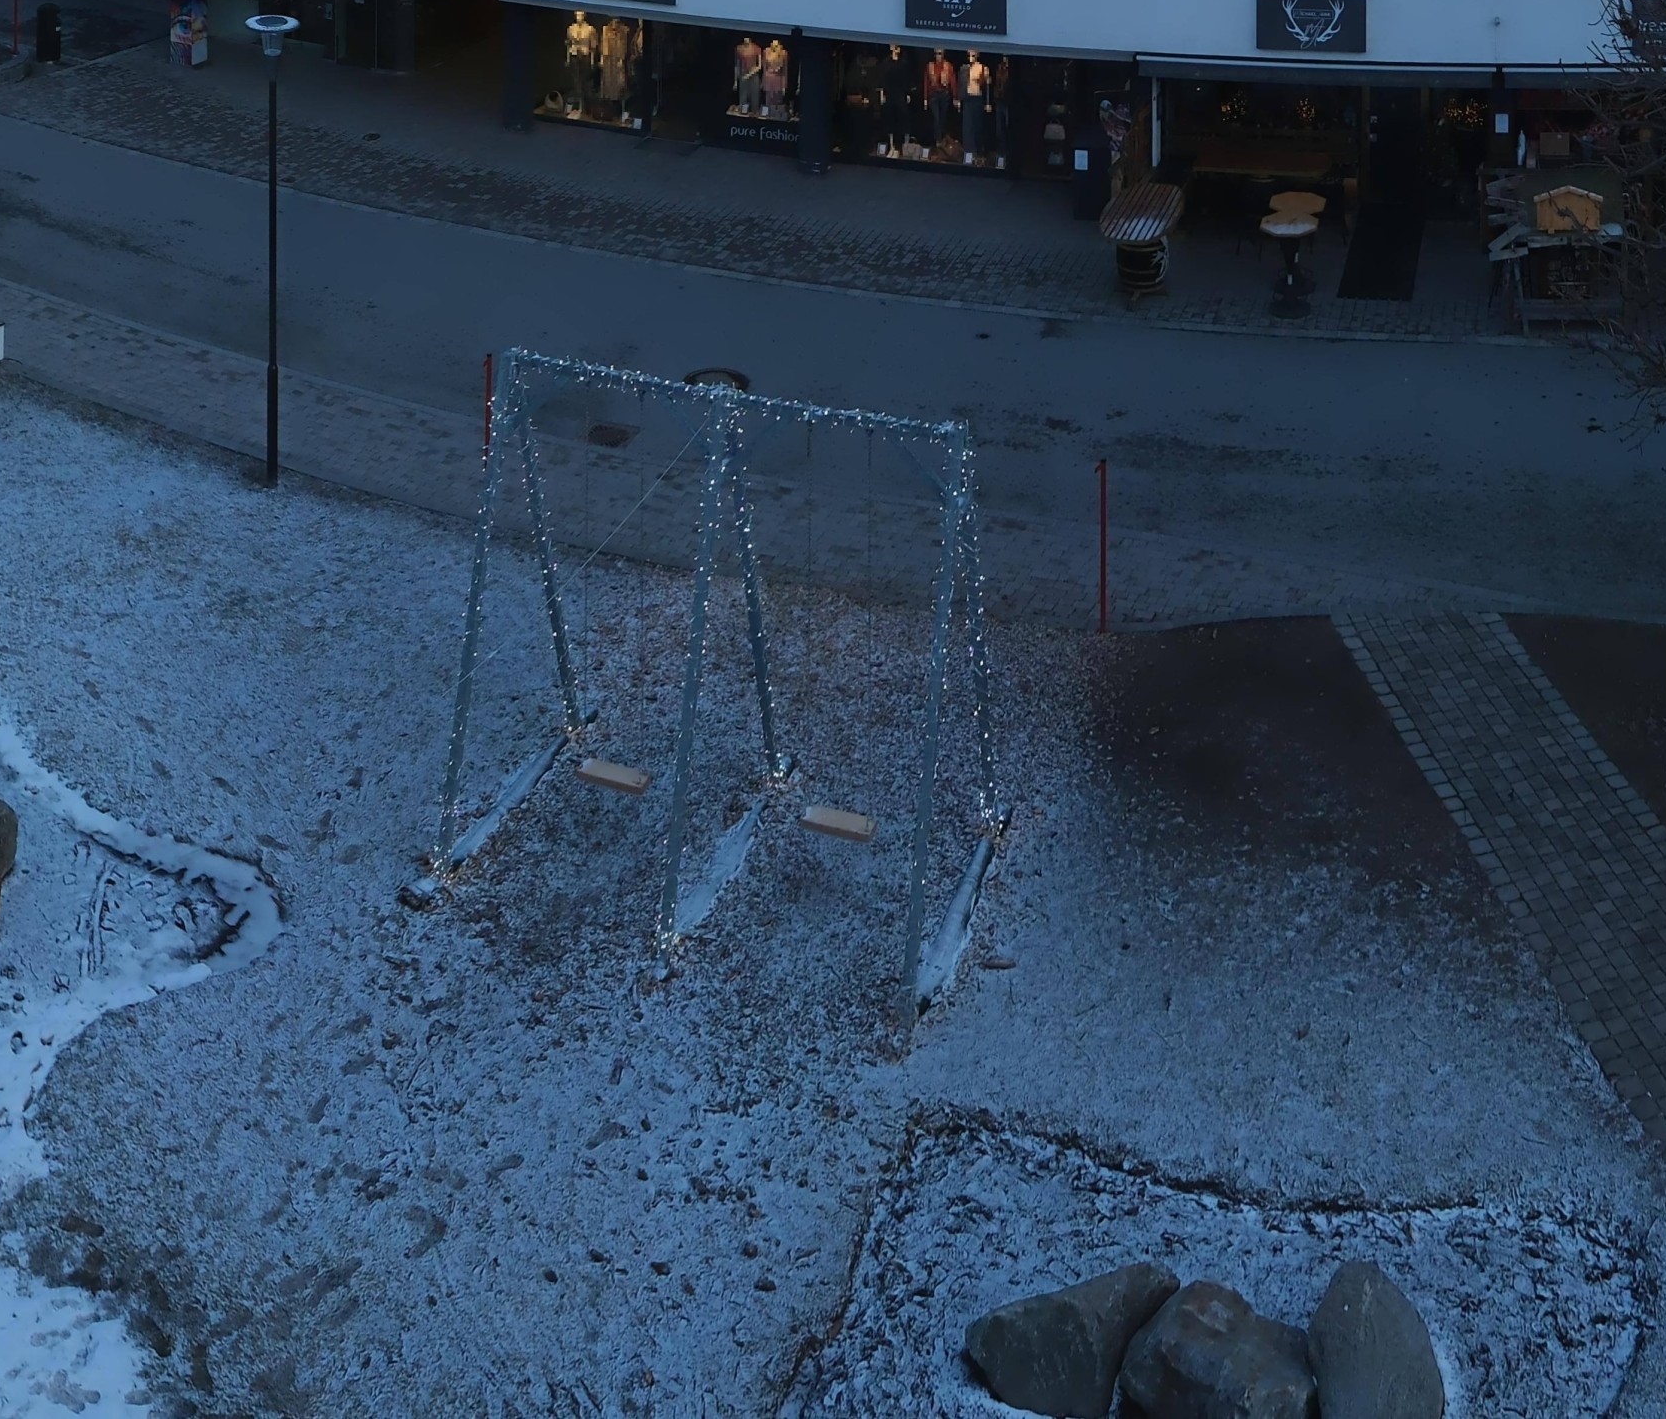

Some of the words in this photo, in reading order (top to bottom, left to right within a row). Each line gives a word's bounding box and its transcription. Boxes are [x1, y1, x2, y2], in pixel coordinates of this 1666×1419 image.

[943, 3, 971, 11] SEEFELD
[915, 19, 945, 27] SEEFELD
[946, 22, 982, 30] SHOPPING
[730, 126, 756, 137] pure
